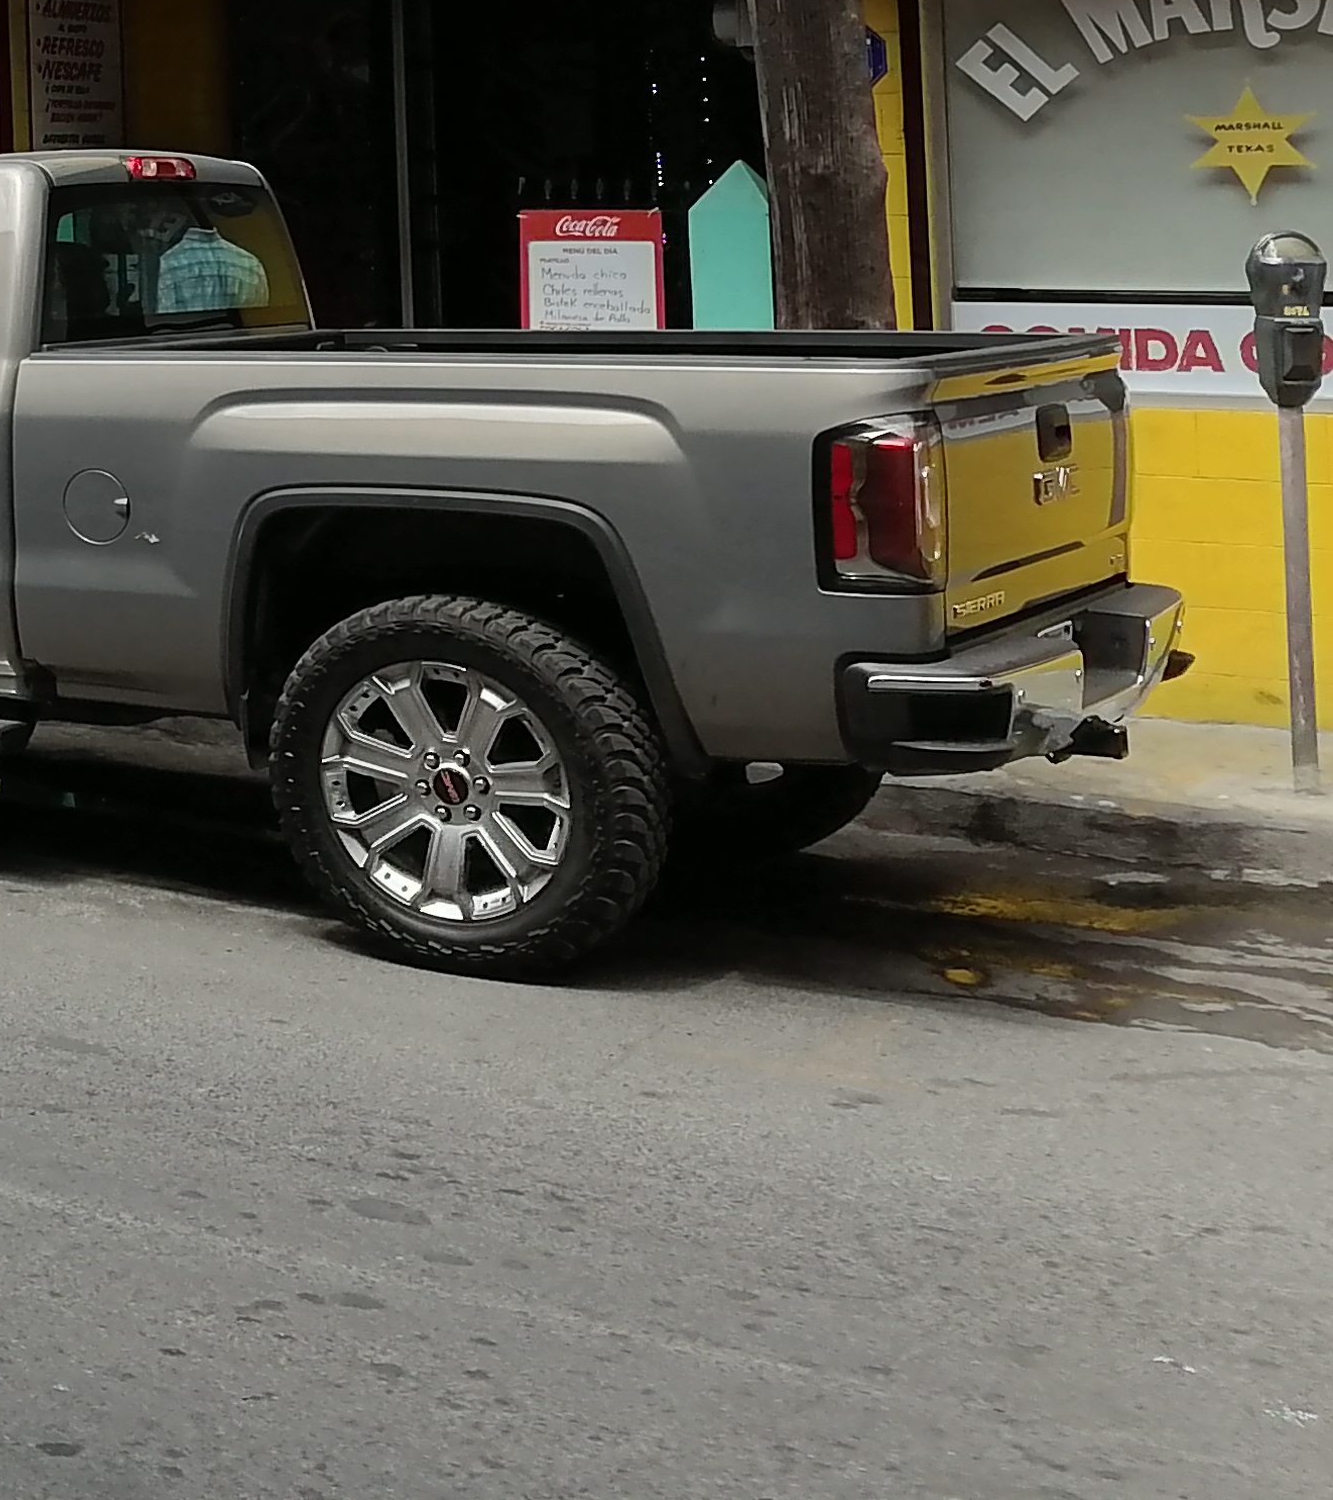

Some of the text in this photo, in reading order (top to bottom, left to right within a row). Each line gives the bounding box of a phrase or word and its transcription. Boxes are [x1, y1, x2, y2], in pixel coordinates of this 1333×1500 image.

[42, 36, 105, 59] REFRESCO
[955, 22, 1081, 122] EL
[1214, 121, 1285, 133] MARSHALL
[1226, 143, 1276, 154] TEXAS
[586, 247, 602, 255] DEL
[543, 283, 577, 297] Chiles
[953, 590, 1006, 619] SIERRA
